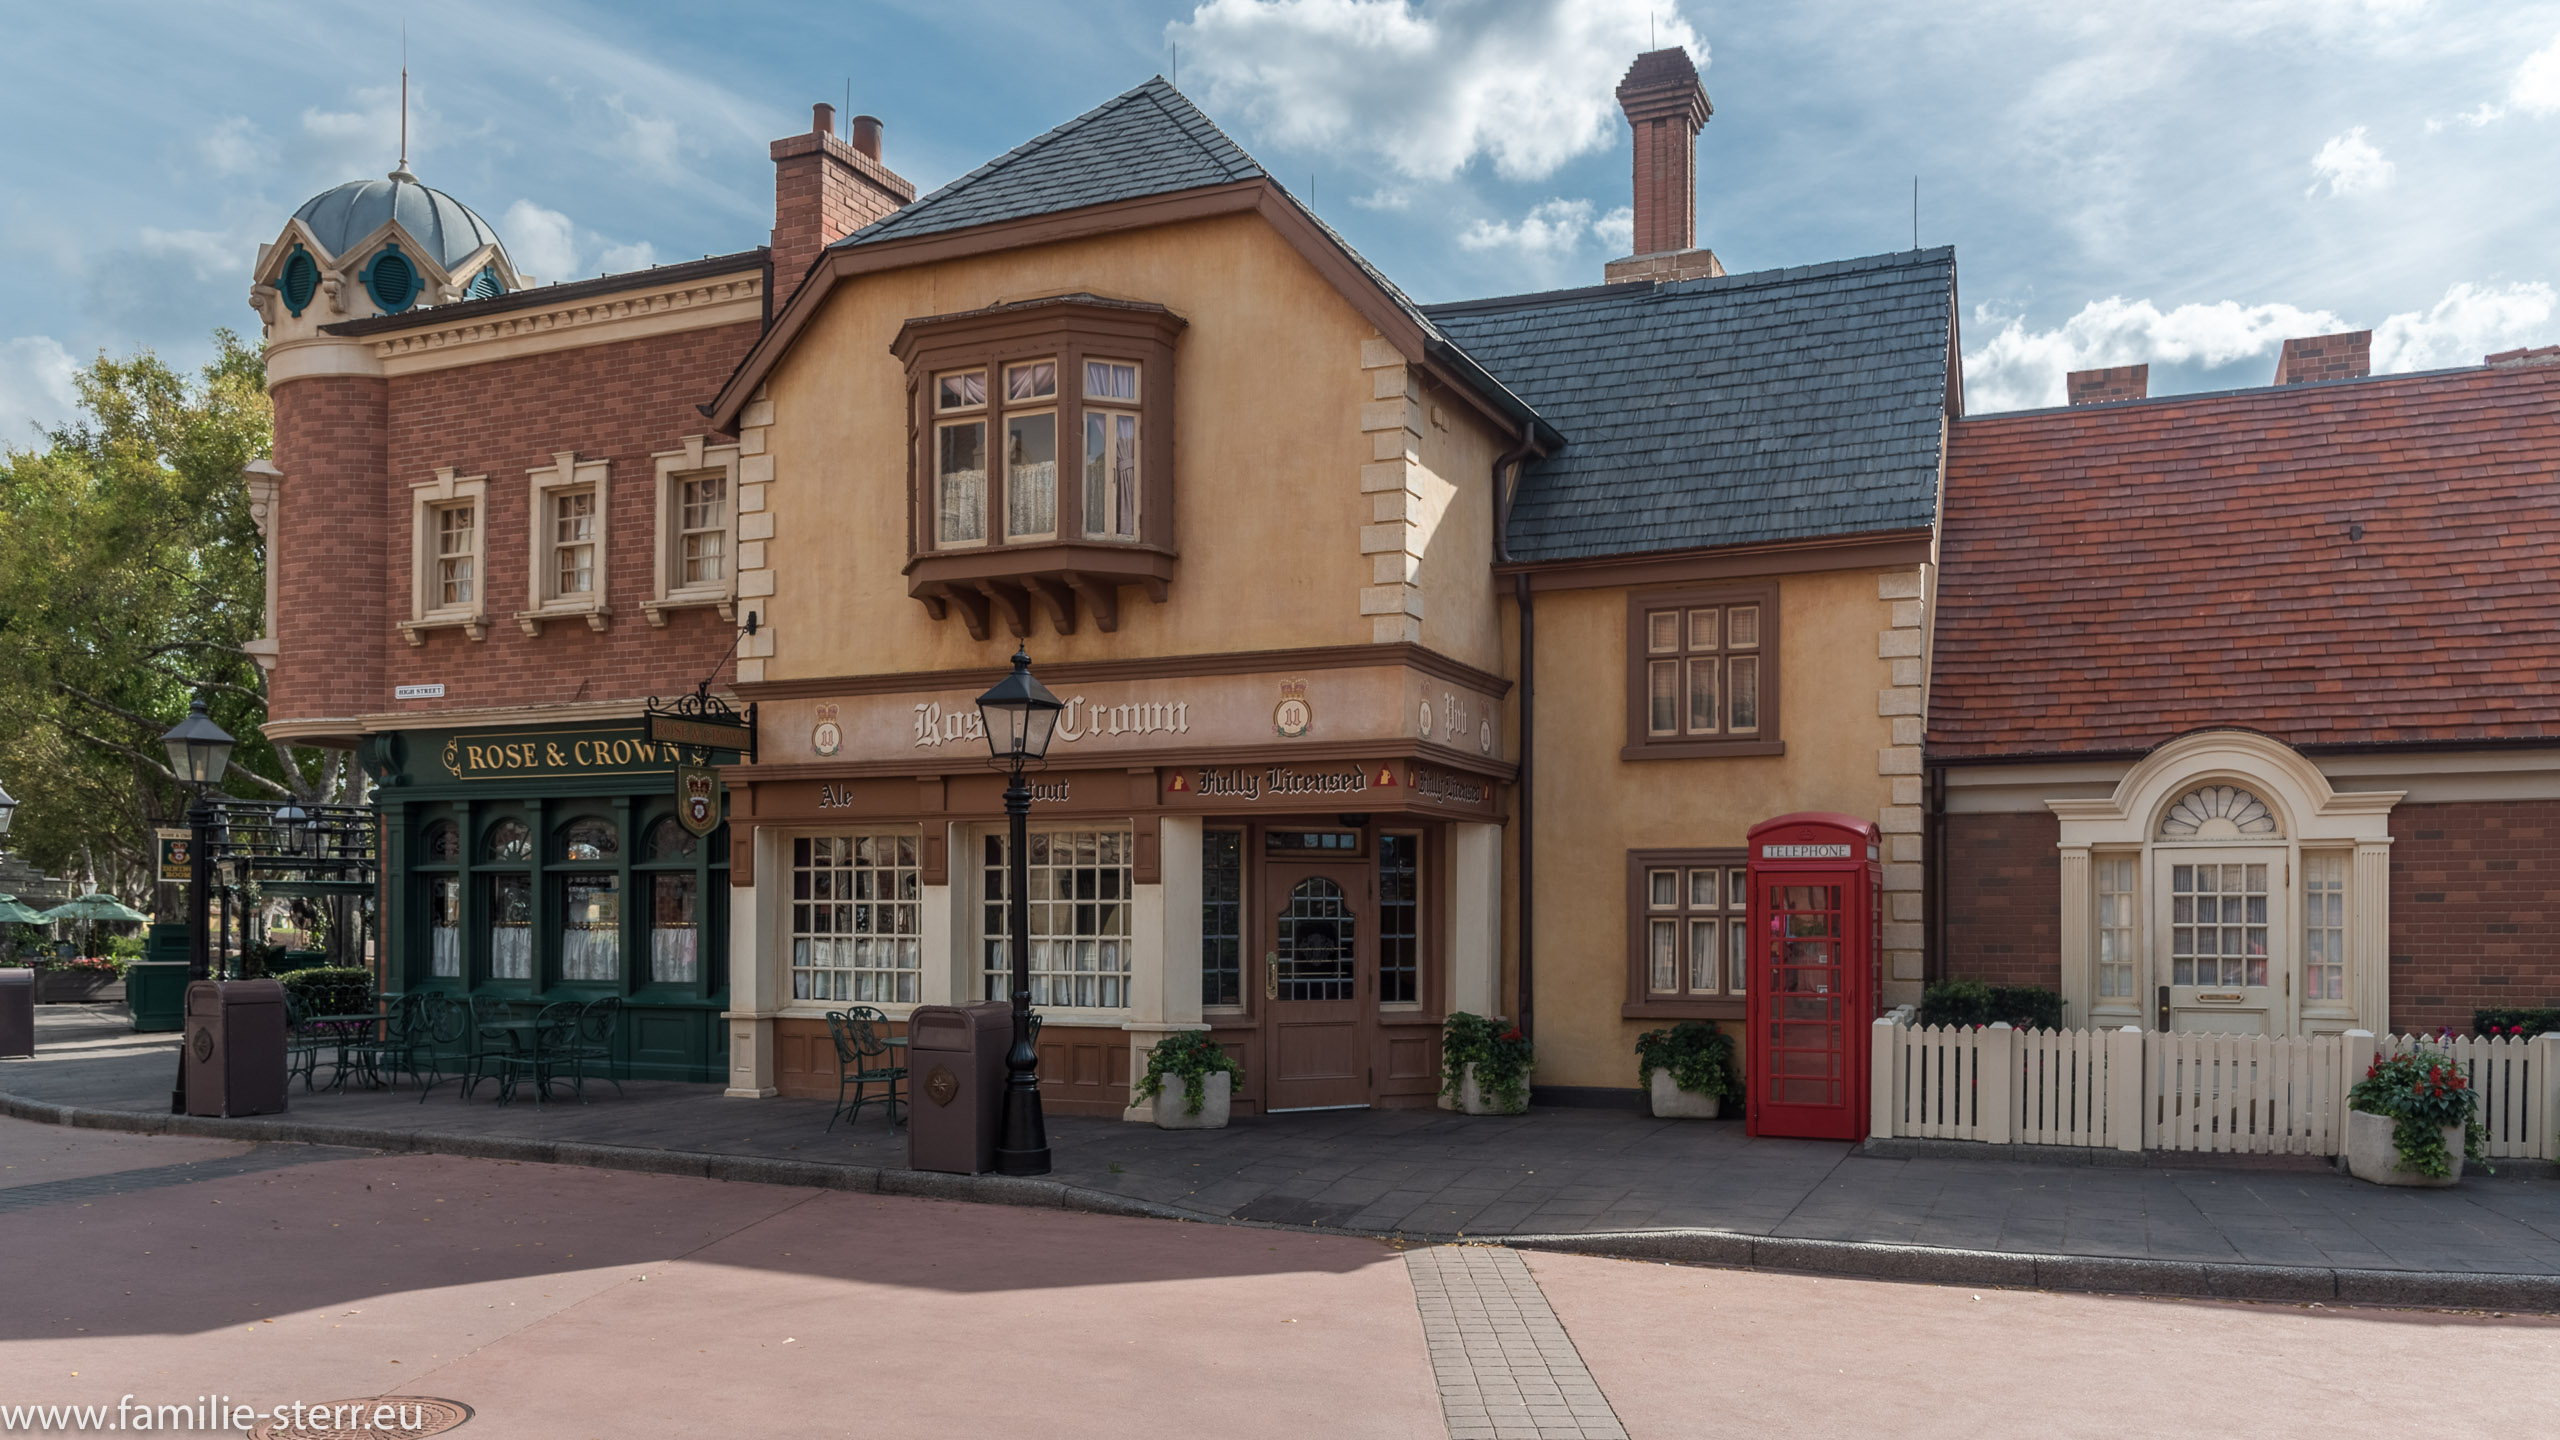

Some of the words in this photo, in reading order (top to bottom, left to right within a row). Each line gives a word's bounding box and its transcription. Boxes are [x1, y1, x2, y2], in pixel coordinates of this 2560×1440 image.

[398, 688, 415, 696] HIGH
[914, 701, 987, 748] Ros
[1056, 695, 1190, 742] Crown
[1444, 692, 1467, 742] Pub
[655, 721, 688, 738] ROSE
[691, 727, 700, 740] &
[703, 727, 748, 746] CROWN
[467, 743, 539, 769] ROSE
[546, 742, 568, 767] &
[574, 739, 681, 766] CROWN
[1027, 778, 1070, 802] tout
[1197, 768, 1261, 800] Fully
[1266, 764, 1367, 795] Licensed
[1418, 768, 1445, 804] Fully
[819, 784, 853, 808] Ale
[1768, 845, 1847, 857] TELEPHONE
